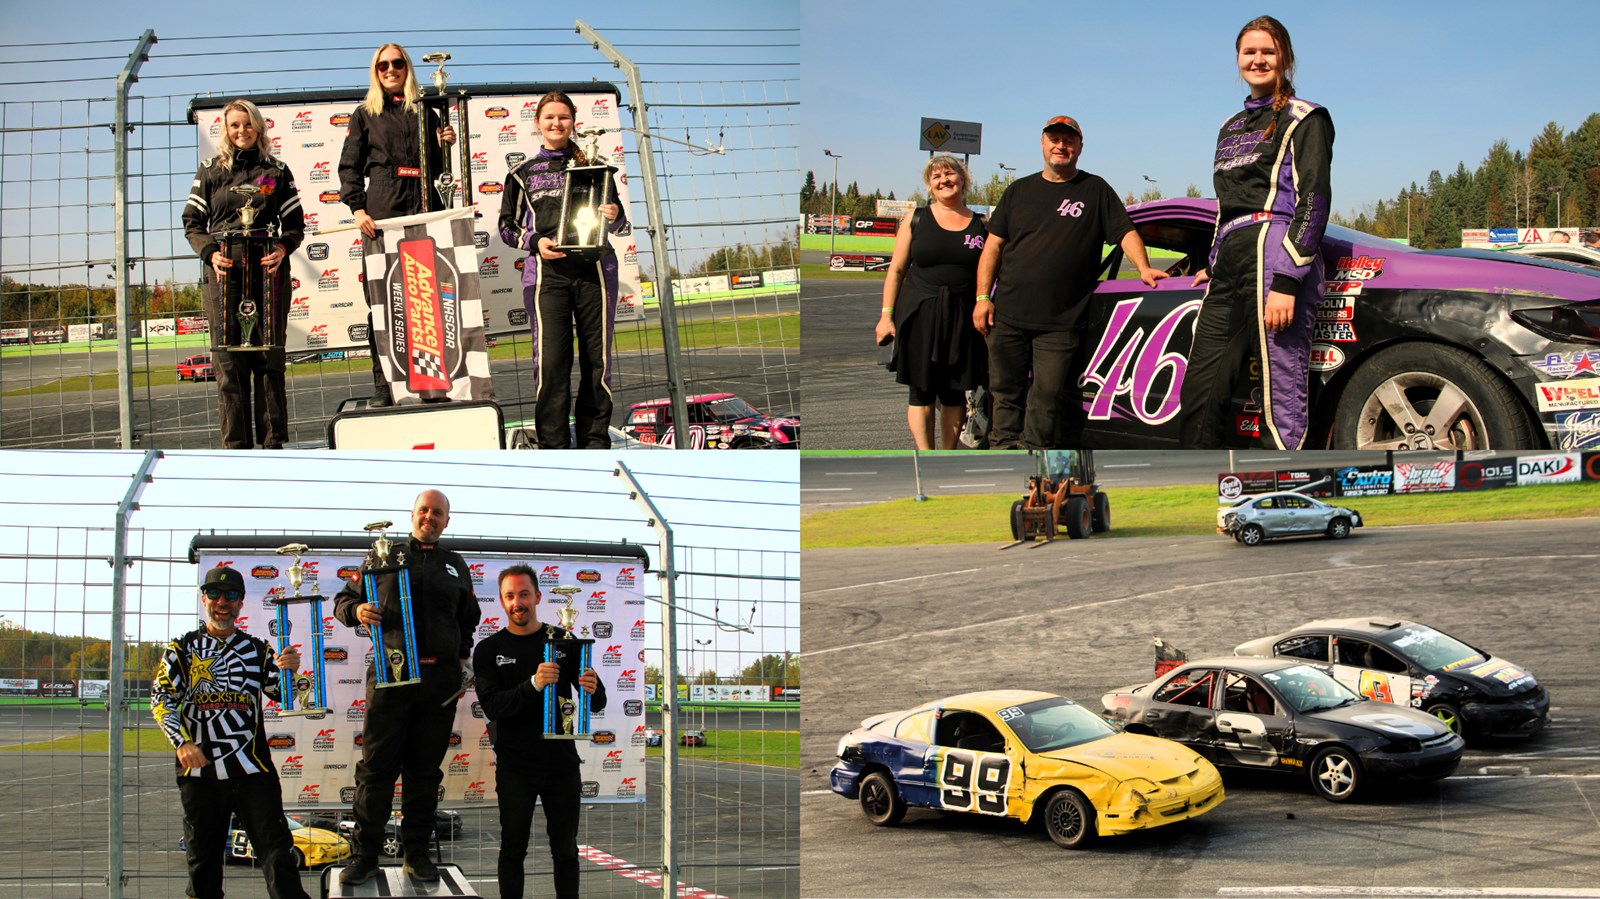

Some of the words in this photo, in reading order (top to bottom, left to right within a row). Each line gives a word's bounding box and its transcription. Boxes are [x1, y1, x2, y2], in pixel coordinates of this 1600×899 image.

[1057, 199, 1085, 217] 46
[964, 234, 985, 249] 46
[1338, 256, 1385, 271] Holley
[402, 251, 417, 296] Auto
[1334, 269, 1376, 280] MSD
[392, 282, 404, 320] WEEKLY
[414, 260, 438, 348] Advance
[408, 294, 424, 345] Parts
[1317, 310, 1348, 318] ELDERS
[149, 325, 174, 333] XPN
[441, 298, 455, 349] NASCAR
[1313, 323, 1350, 331] ARTER
[394, 318, 406, 353] SERIES
[1078, 297, 1203, 425] 46
[1310, 350, 1337, 362] ELL
[1519, 460, 1560, 476] DAKI
[997, 706, 1025, 721] 99
[940, 748, 1012, 816] 99
